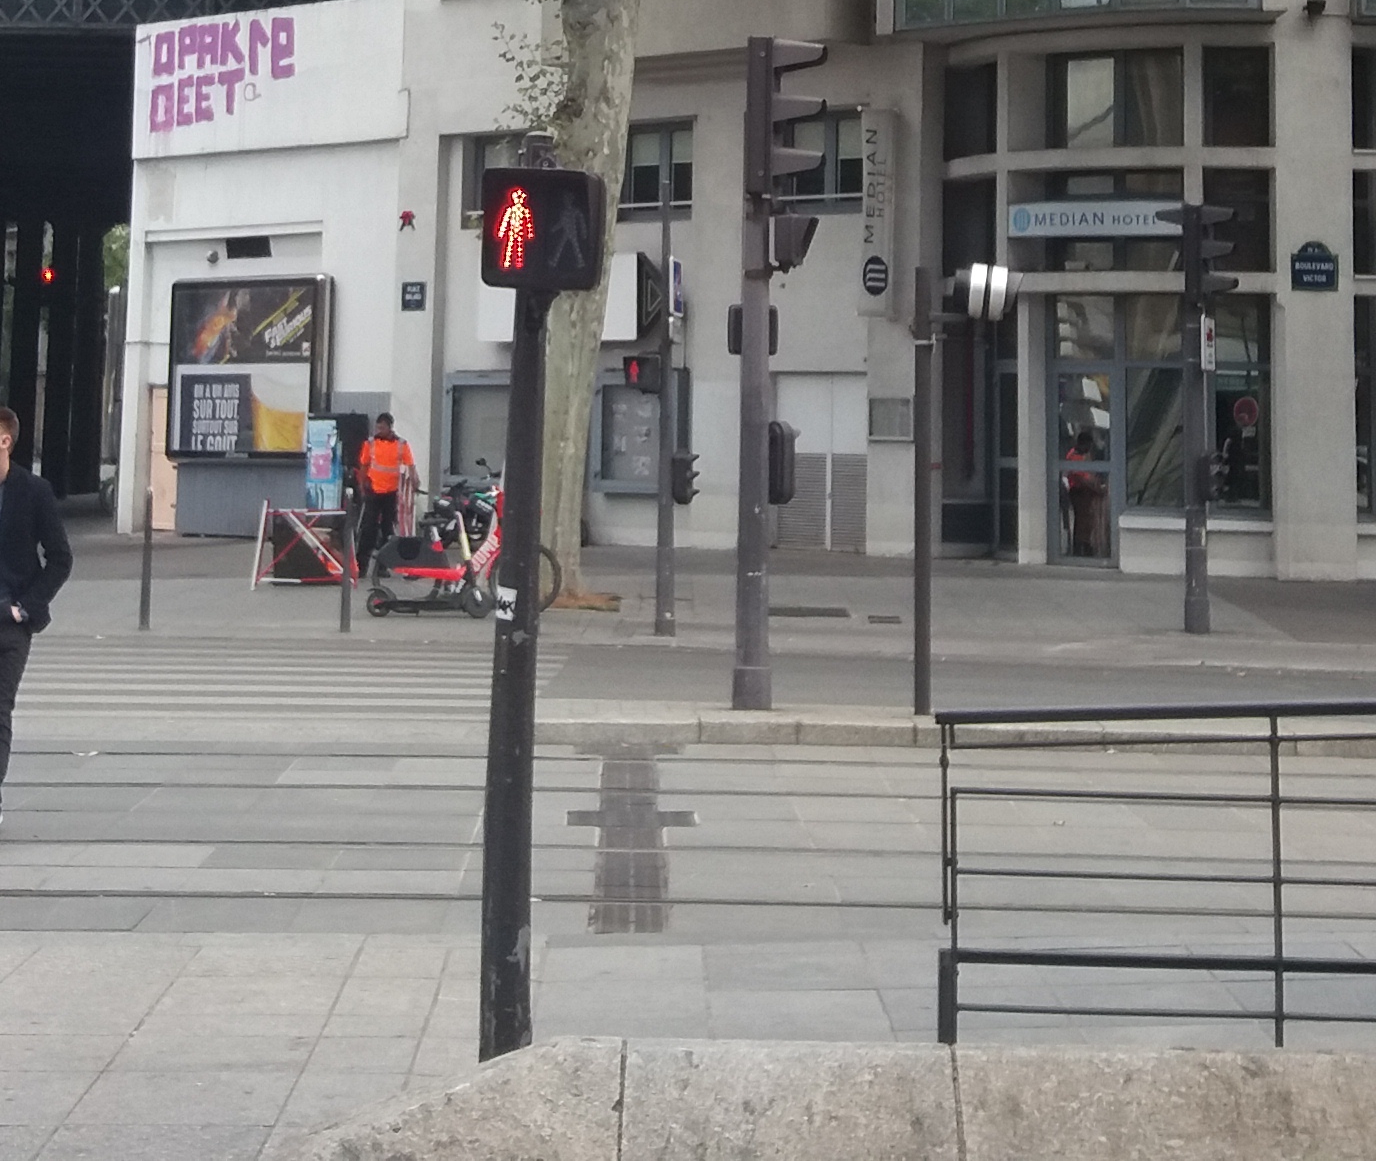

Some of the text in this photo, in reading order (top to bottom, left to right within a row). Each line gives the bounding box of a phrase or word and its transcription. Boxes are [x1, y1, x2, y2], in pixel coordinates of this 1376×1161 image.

[864, 129, 878, 244] MEDIAN
[876, 158, 887, 218] HOTEL
[1034, 212, 1105, 227] MEDIAN
[1295, 261, 1335, 271] BOULEVARD
[193, 399, 213, 419] SUR
[471, 534, 501, 573] JUMP
